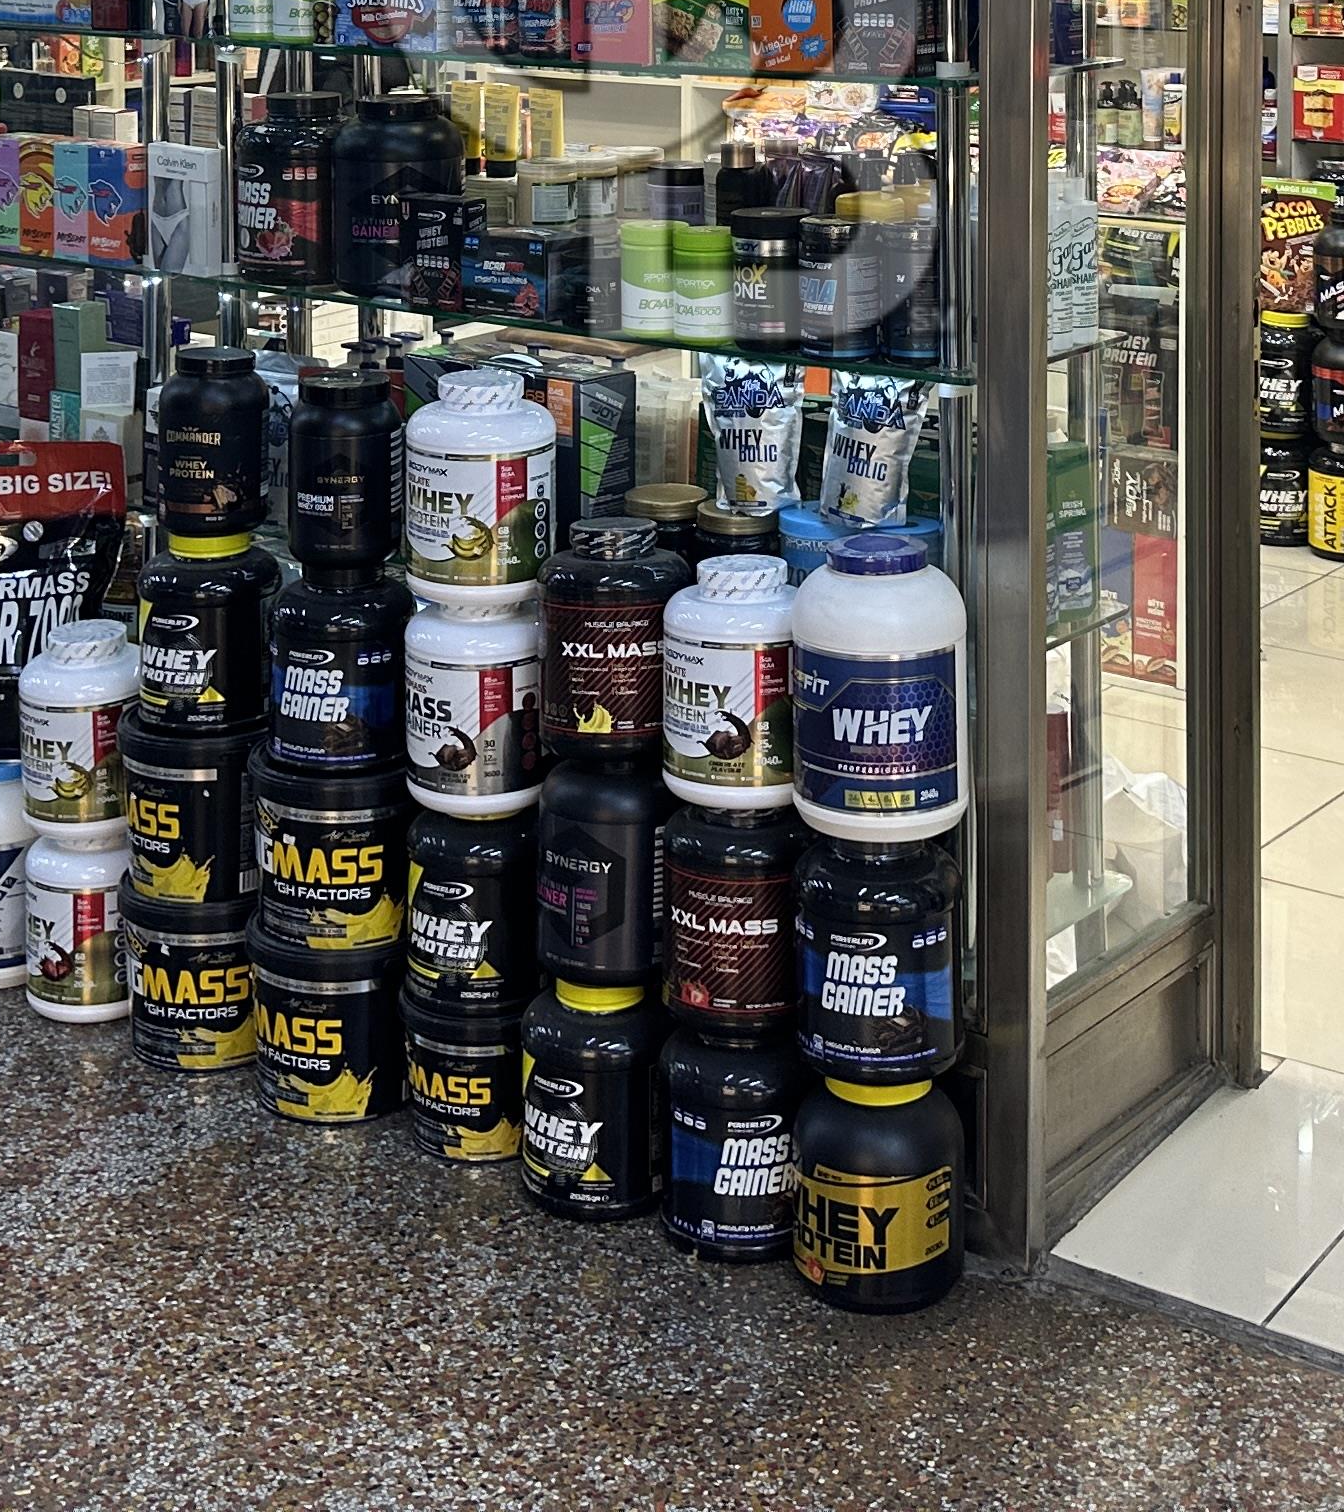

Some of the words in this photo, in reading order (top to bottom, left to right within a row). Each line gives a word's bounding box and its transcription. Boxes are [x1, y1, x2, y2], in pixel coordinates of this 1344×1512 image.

[788, 0, 815, 15] HIGH
[156, 154, 180, 167] Calvin
[181, 156, 198, 170] Klein
[417, 236, 448, 249] PROTEIN
[418, 226, 442, 238] WHEY
[716, 387, 785, 409] PANDA
[719, 428, 763, 451] WHEY
[738, 443, 778, 464] BOLIC
[169, 467, 215, 480] PROTEIN
[175, 459, 207, 471] WHEY
[48, 471, 112, 491] SIZE!
[317, 474, 365, 485] SYNERGY
[297, 490, 334, 504] PREMIUM
[1324, 482, 1338, 551] ATTACK
[140, 647, 218, 670] WHEY
[561, 640, 604, 659] XXL
[141, 666, 205, 686] PROTEIN
[284, 665, 344, 695] MASS
[280, 692, 350, 723] GAINER
[832, 703, 933, 746] WHEY
[484, 739, 496, 750] 30
[545, 849, 612, 875] SYNERGY
[297, 885, 372, 901] FACTORS
[411, 908, 493, 943] WHEY
[670, 905, 705, 931] XXL
[708, 918, 778, 936] MASS
[825, 951, 898, 985] MASS
[167, 1004, 238, 1020] FACTORS
[820, 986, 906, 1018] GAINER
[523, 1101, 604, 1144] WHEY
[719, 1133, 791, 1166] MASS
